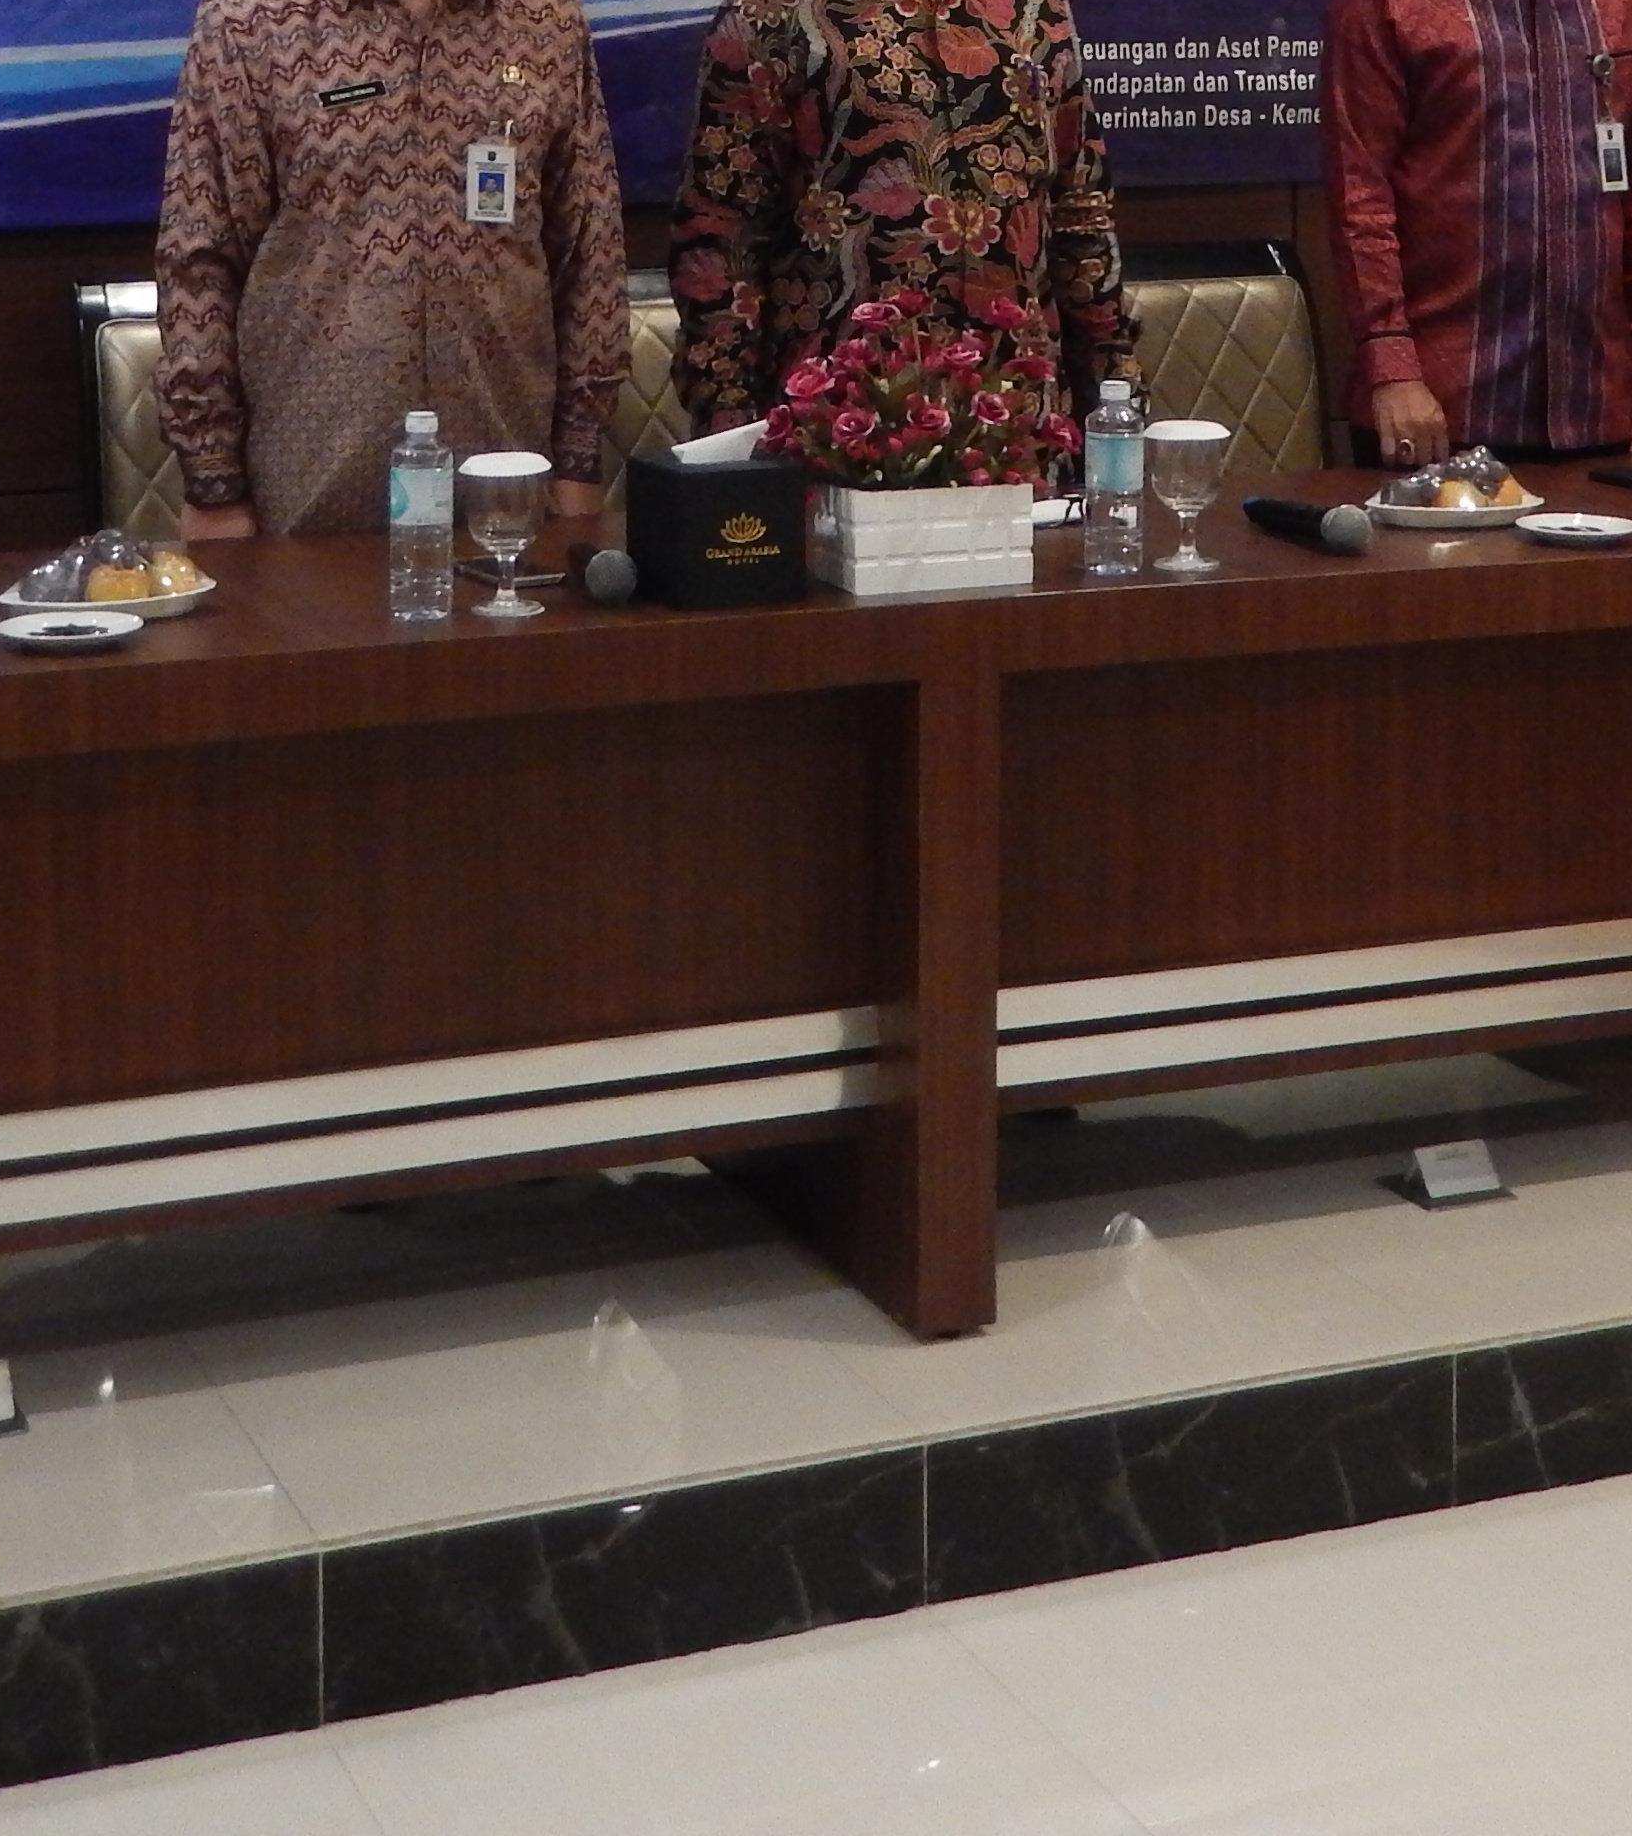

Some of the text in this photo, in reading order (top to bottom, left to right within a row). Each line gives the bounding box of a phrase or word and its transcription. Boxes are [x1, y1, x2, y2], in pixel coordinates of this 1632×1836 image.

[1079, 39, 1168, 65] euangan
[1174, 36, 1210, 60] dan
[1215, 36, 1261, 59] Aset
[1084, 68, 1316, 100] endapatan dan Transfer
[1095, 105, 1197, 129] erintahan
[1204, 104, 1253, 127] Desa
